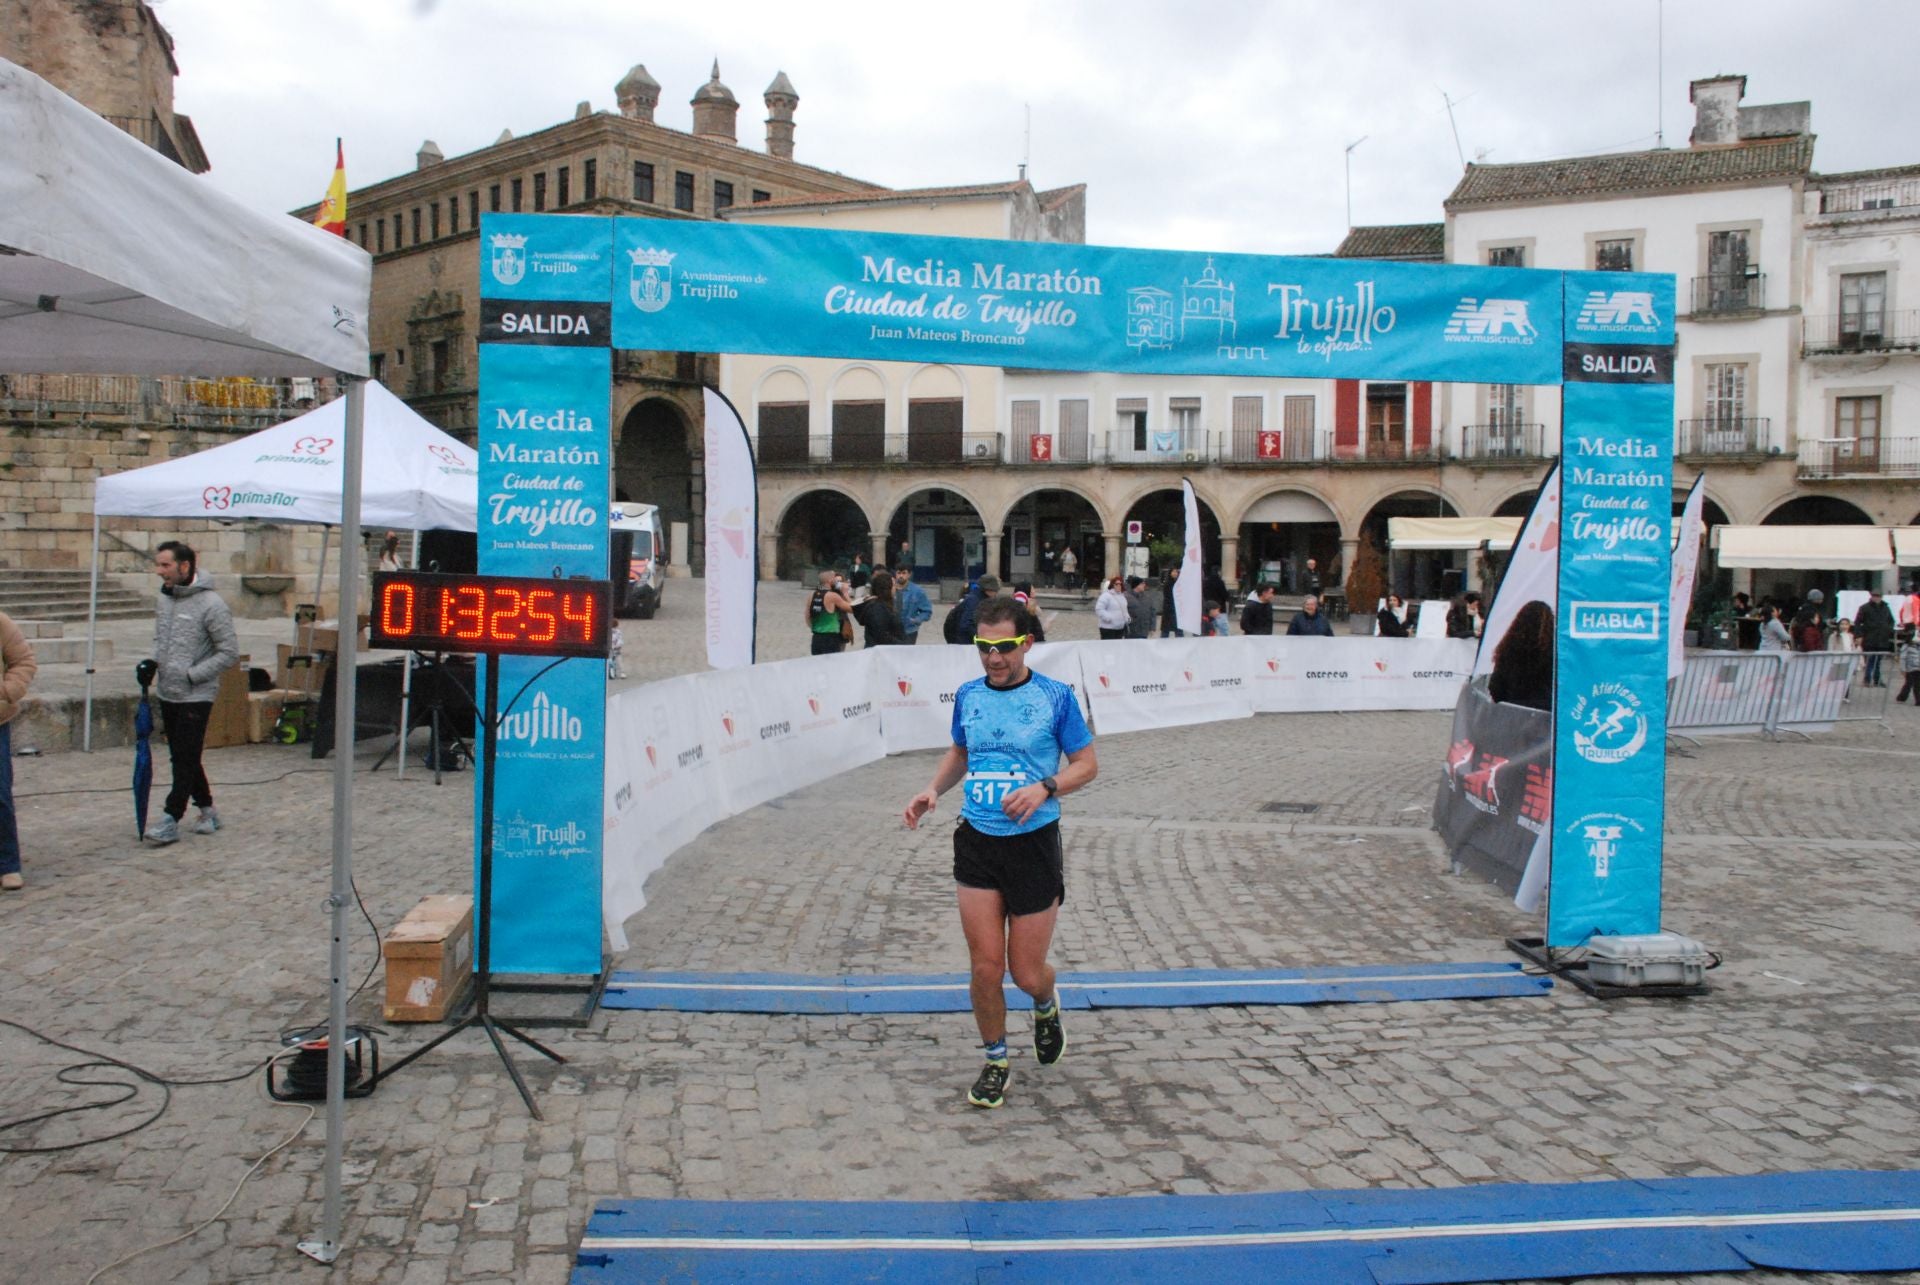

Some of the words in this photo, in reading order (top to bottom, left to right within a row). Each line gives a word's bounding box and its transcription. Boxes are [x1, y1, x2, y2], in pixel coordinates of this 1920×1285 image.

[531, 251, 587, 262] Ayuntamiento
[588, 253, 601, 262] de
[531, 261, 578, 276] Trujillo
[680, 270, 753, 284] Ayuntamiento
[754, 273, 768, 284] de
[861, 255, 962, 288] Media
[971, 262, 1103, 296] Maratón
[679, 283, 739, 302] Trujillo
[824, 285, 928, 318] Ciudad
[932, 296, 970, 321] de
[977, 293, 1077, 335] Trujillo
[1267, 281, 1397, 345] Trujillo
[501, 312, 590, 335] SALIDA
[1576, 322, 1657, 333] www.musicrun.es
[869, 325, 903, 340] Juan
[907, 326, 957, 342] Mateos
[961, 330, 1026, 345] Broncano
[1297, 334, 1312, 354] te
[1444, 333, 1534, 345] www.musicrun.es
[1582, 354, 1656, 374] SALIDA
[496, 408, 593, 432] Media
[488, 442, 600, 465] Maratón
[1576, 437, 1659, 458] Media
[255, 453, 335, 468] primaflor
[503, 472, 560, 491] Ciudad
[563, 476, 584, 491] de
[1573, 467, 1664, 487] Maratón
[232, 492, 299, 508] primaflor
[1582, 494, 1628, 510] Ciudad
[1631, 497, 1649, 510] de
[488, 493, 597, 537] Trujillo
[1570, 512, 1661, 550] Trujillo
[493, 540, 514, 551] Juan
[516, 541, 548, 551] Mateos
[551, 541, 594, 552] Broncano
[1582, 613, 1645, 629] HABLA
[1571, 695, 1588, 721] Club
[1592, 682, 1642, 707] Atletismo
[1578, 744, 1632, 759] TRUJILLO
[532, 821, 586, 845] Trujillo
